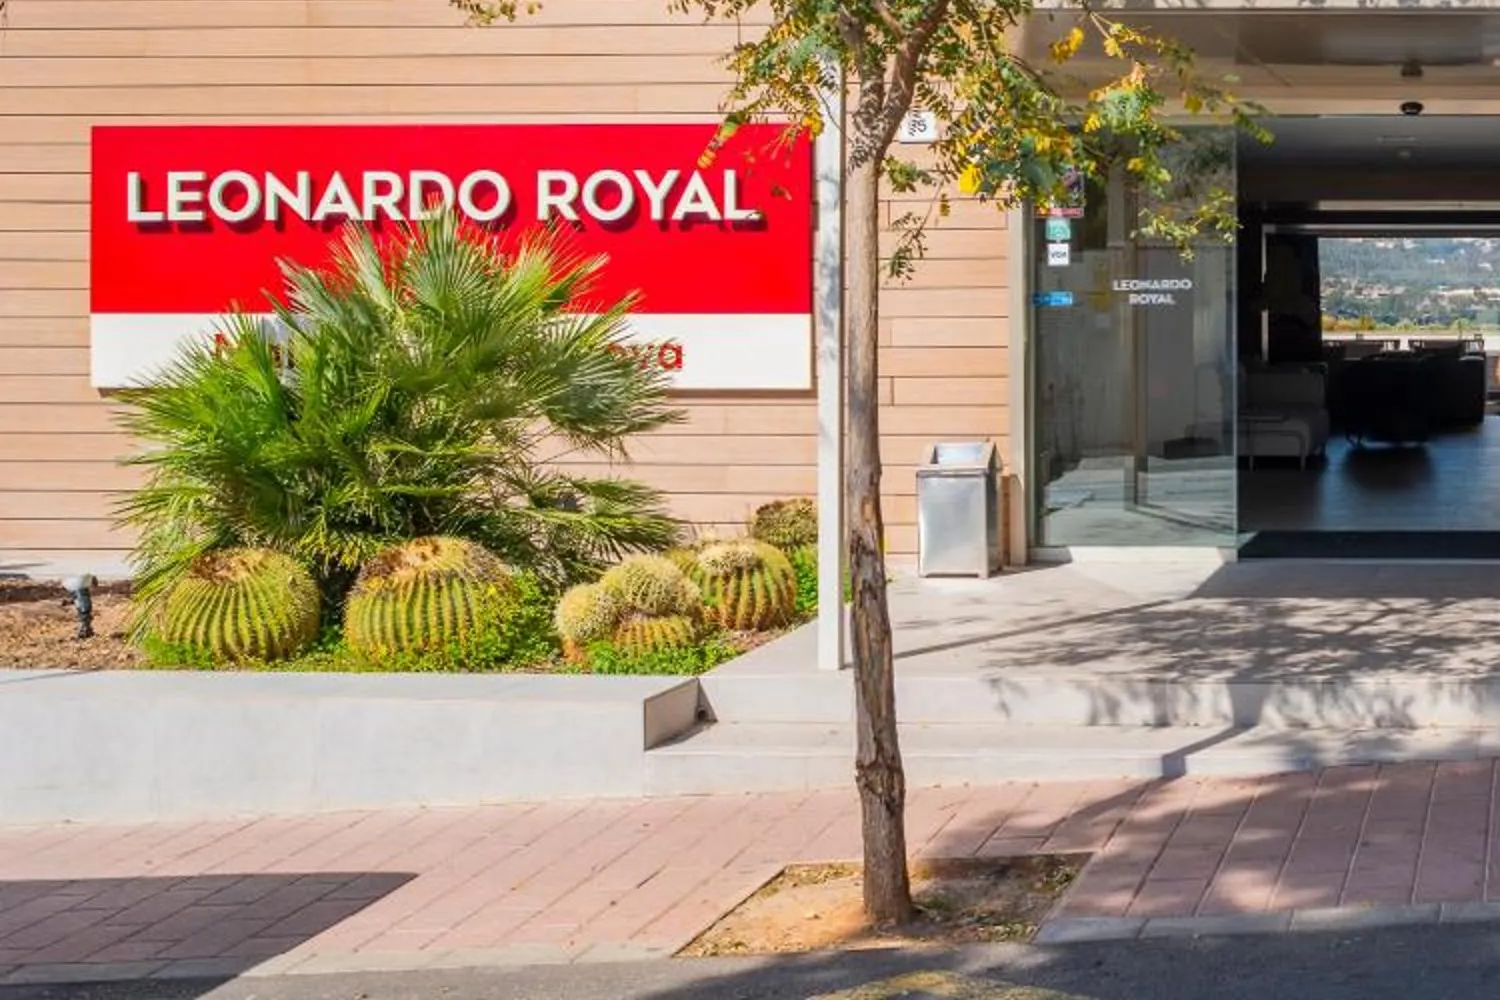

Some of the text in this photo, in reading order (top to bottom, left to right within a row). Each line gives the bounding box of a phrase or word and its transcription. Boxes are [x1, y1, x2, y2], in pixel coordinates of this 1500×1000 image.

[126, 168, 764, 222] LEONARDO ROYAL
[1113, 278, 1193, 291] LEONARDO
[1128, 293, 1176, 305] ROYAL
